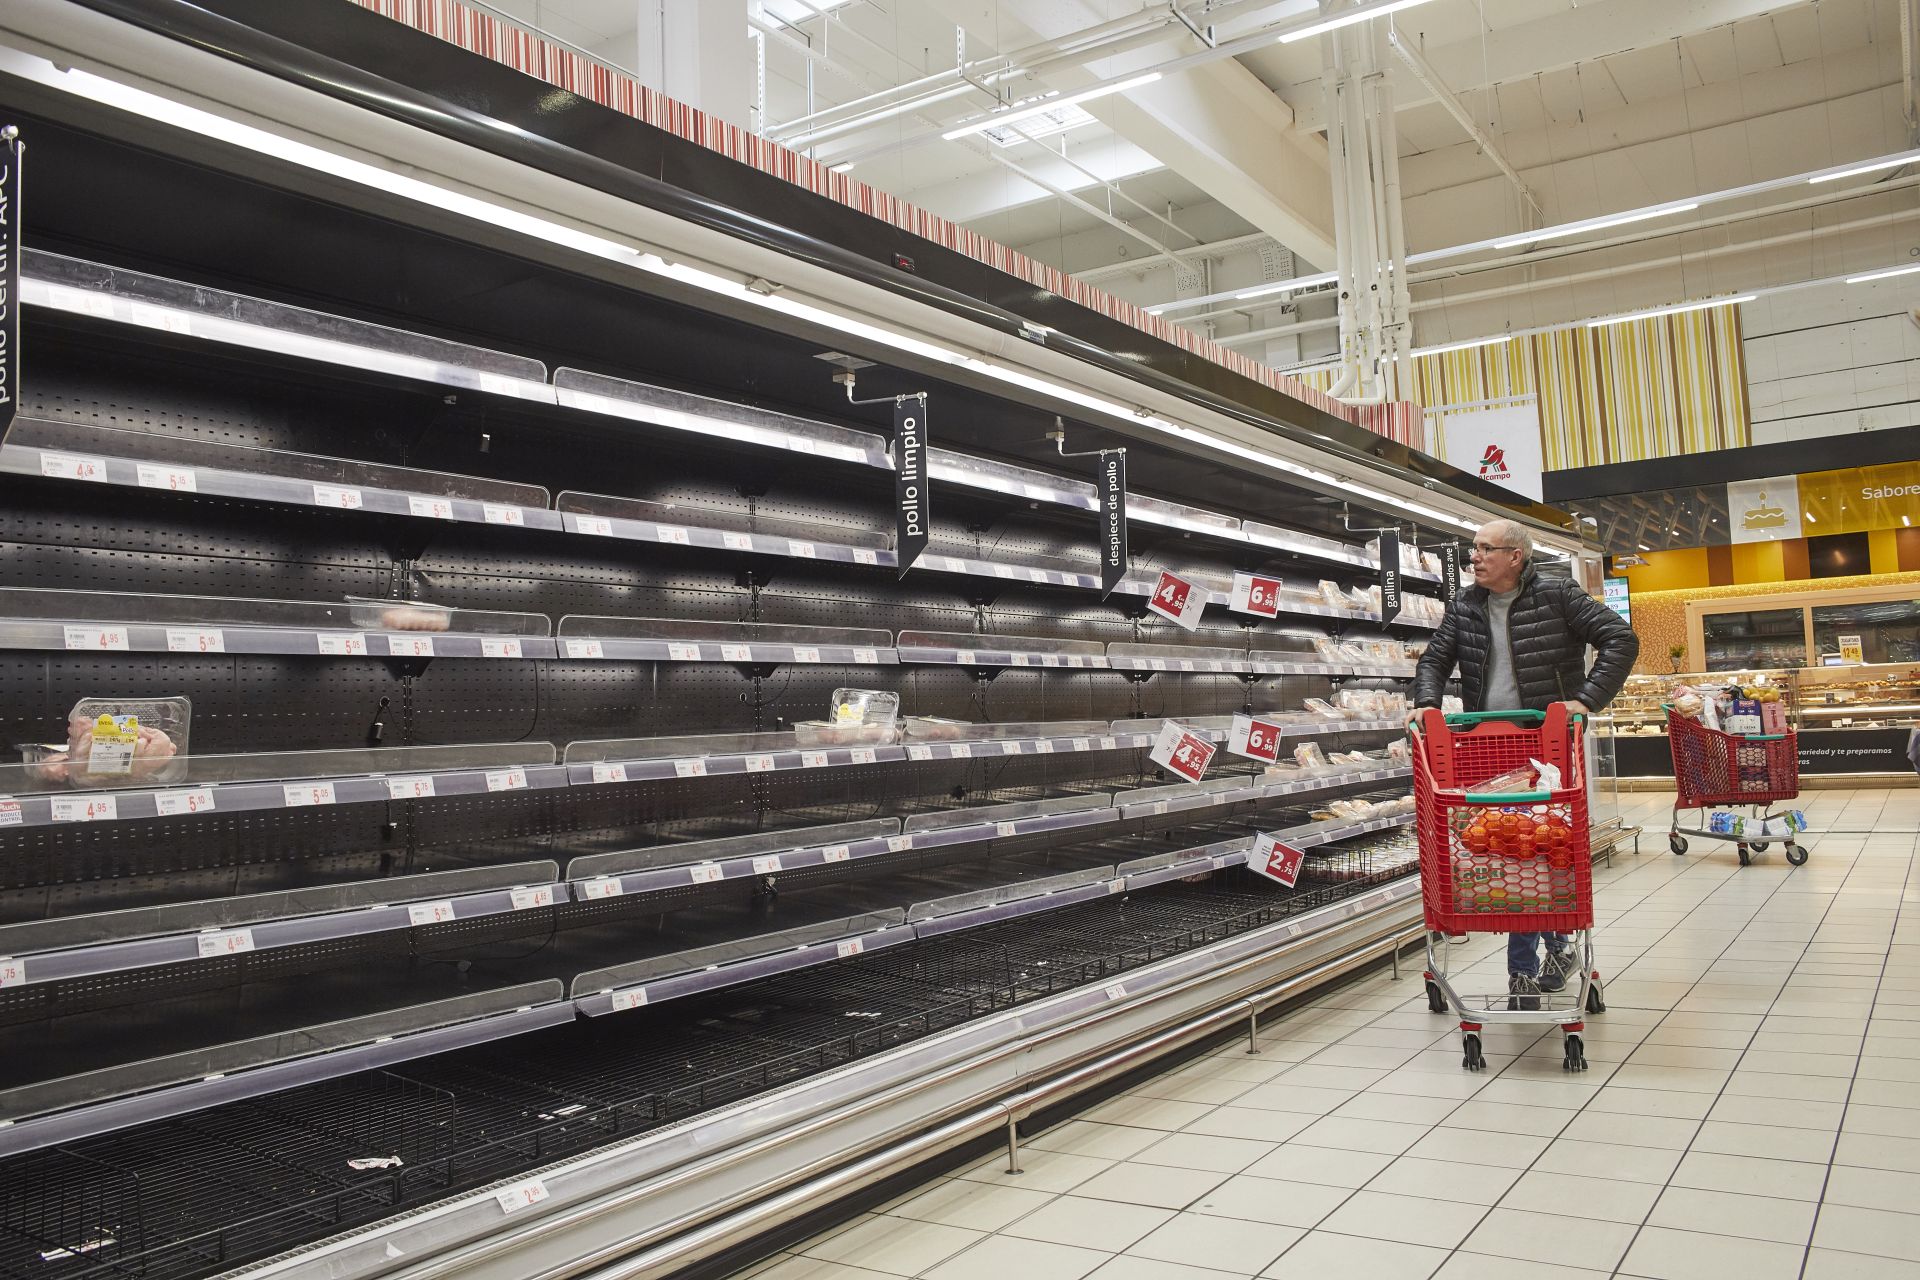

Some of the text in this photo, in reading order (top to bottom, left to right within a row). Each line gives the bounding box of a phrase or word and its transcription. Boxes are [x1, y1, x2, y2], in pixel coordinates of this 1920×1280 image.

[900, 417, 923, 536] pollo limpio
[1106, 461, 1121, 566] despiece de pollo
[1384, 570, 1398, 608] gallina
[1446, 547, 1456, 602] aborados ave
[1797, 748, 1830, 756] variedad
[1830, 749, 1836, 757] y
[1846, 748, 1892, 756] preparamos
